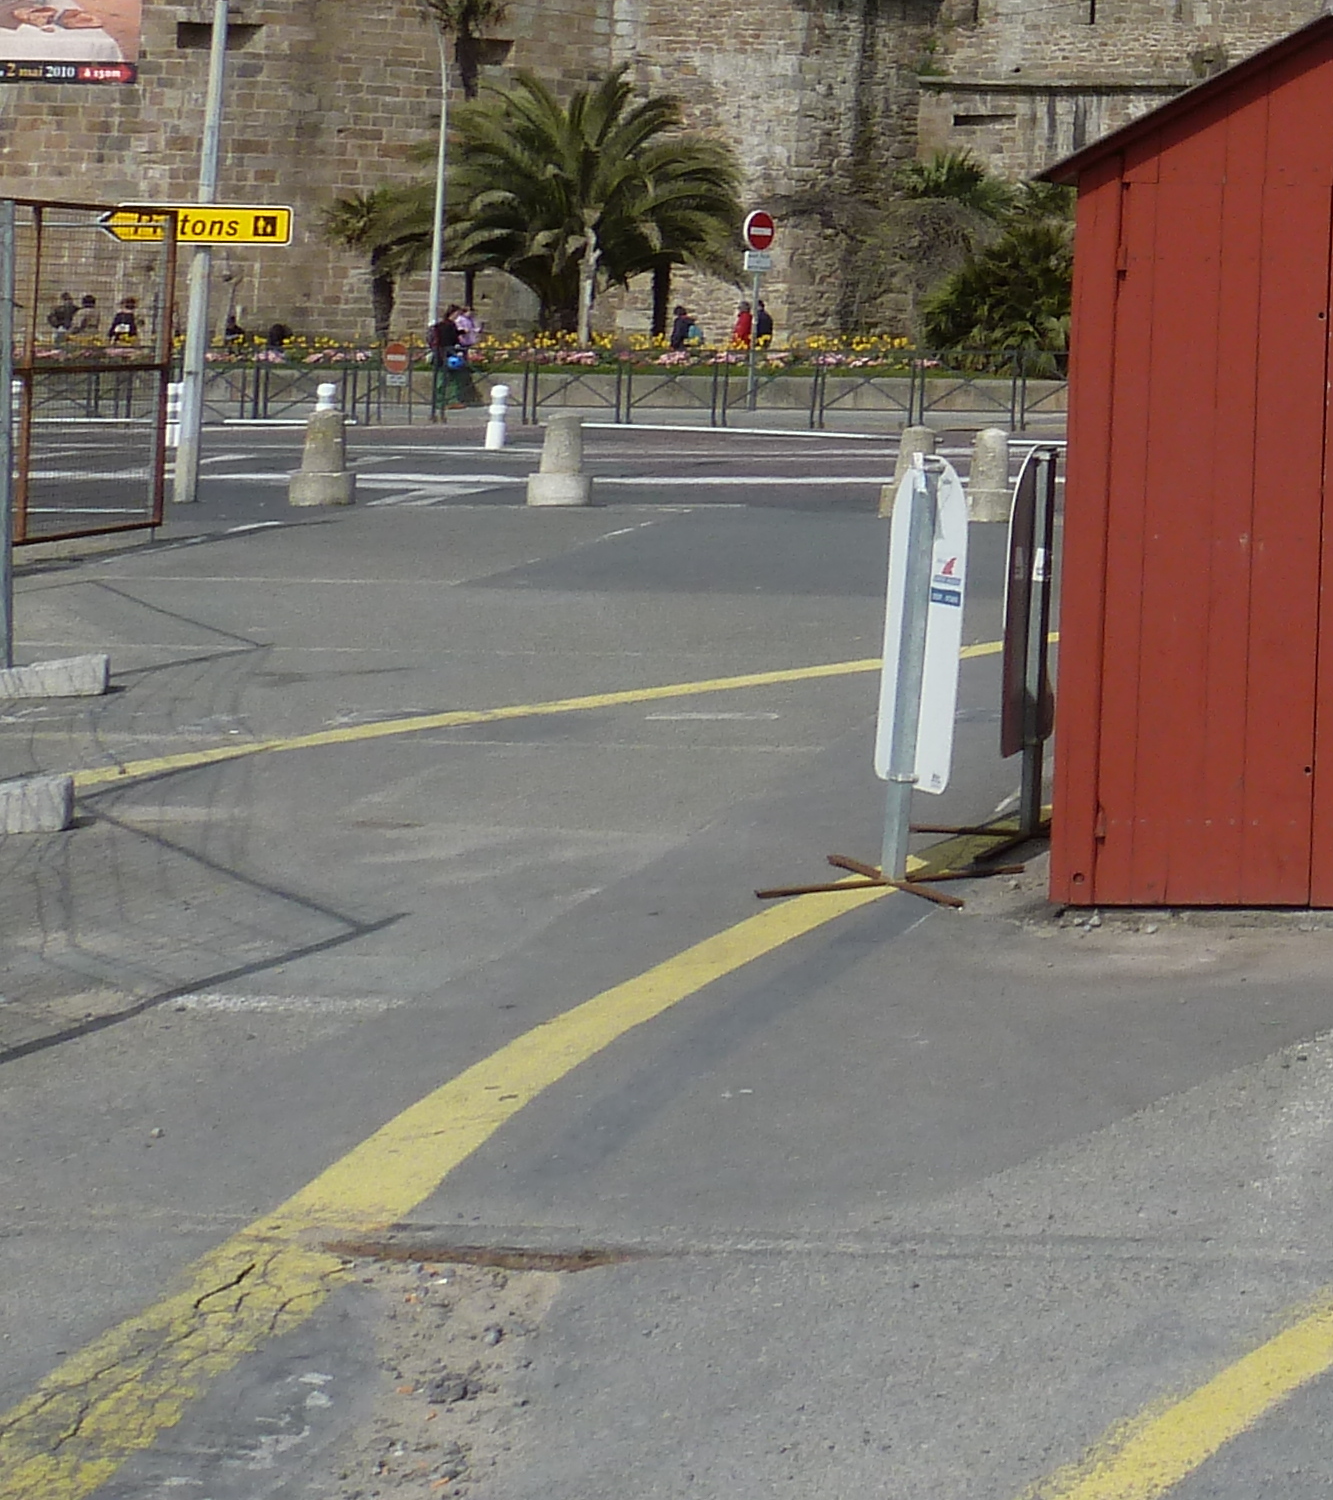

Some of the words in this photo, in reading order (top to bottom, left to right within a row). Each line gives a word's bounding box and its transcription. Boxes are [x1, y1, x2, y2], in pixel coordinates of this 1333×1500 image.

[6, 62, 16, 77] 2
[19, 66, 42, 77] mai
[45, 66, 75, 78] 2010
